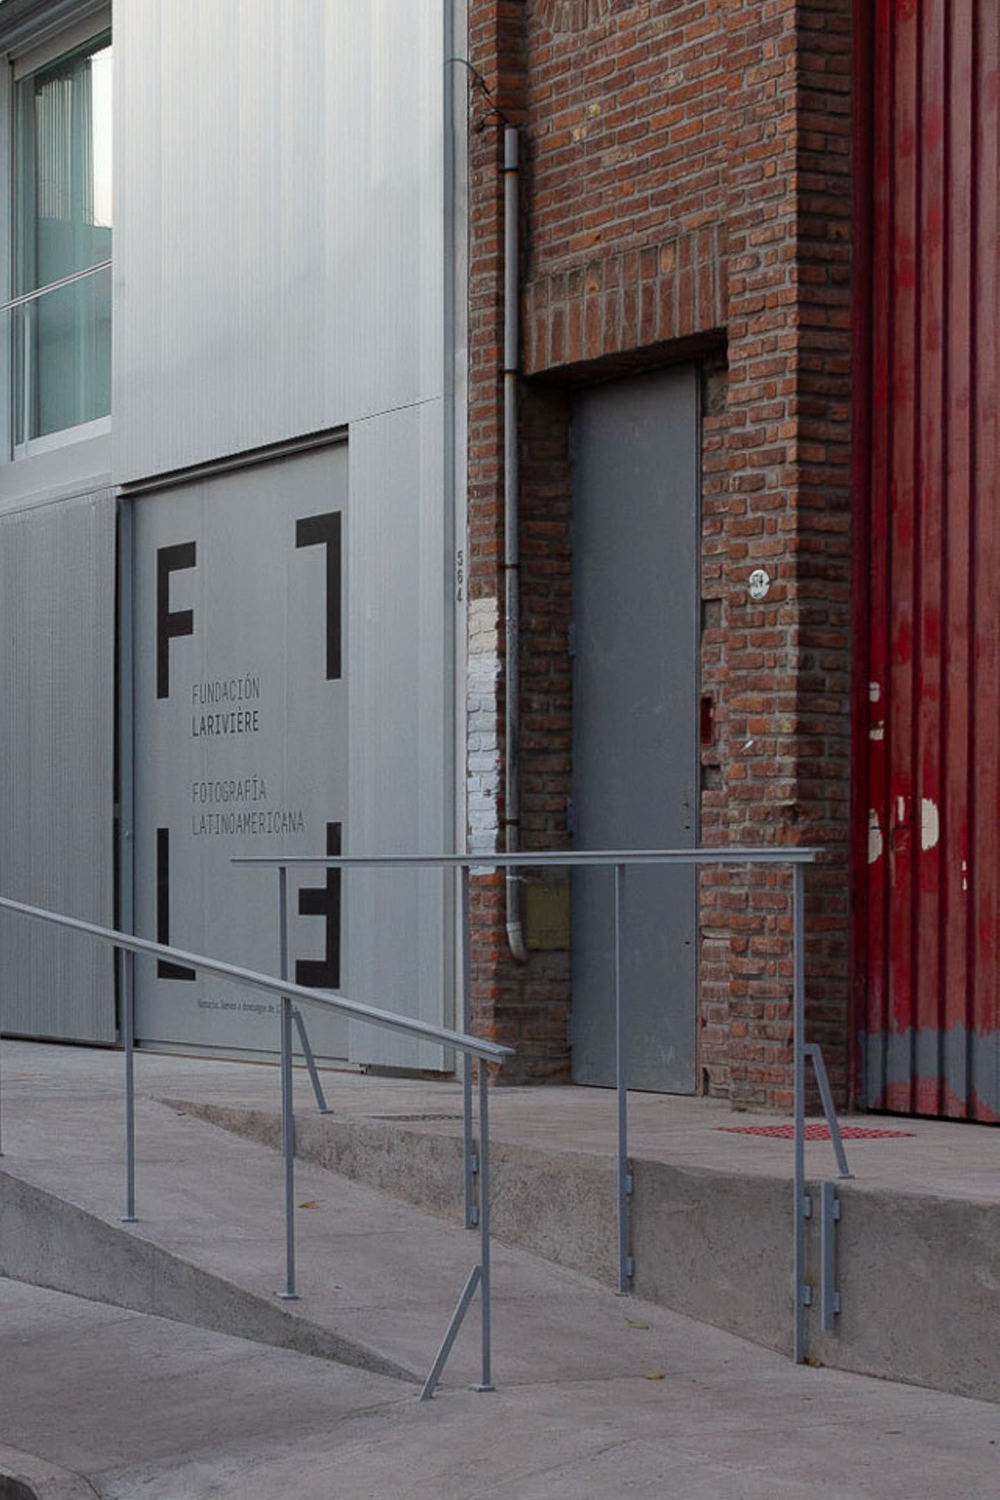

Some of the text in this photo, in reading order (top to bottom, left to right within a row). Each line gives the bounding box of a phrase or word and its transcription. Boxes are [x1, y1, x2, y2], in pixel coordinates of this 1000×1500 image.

[156, 541, 197, 700] F
[191, 672, 261, 705] FUNDACIÓN
[191, 706, 260, 737] LARIVIÈRE
[191, 773, 267, 804] FOTOGRAFÍA
[191, 810, 305, 836] LATINOAMERICANA
